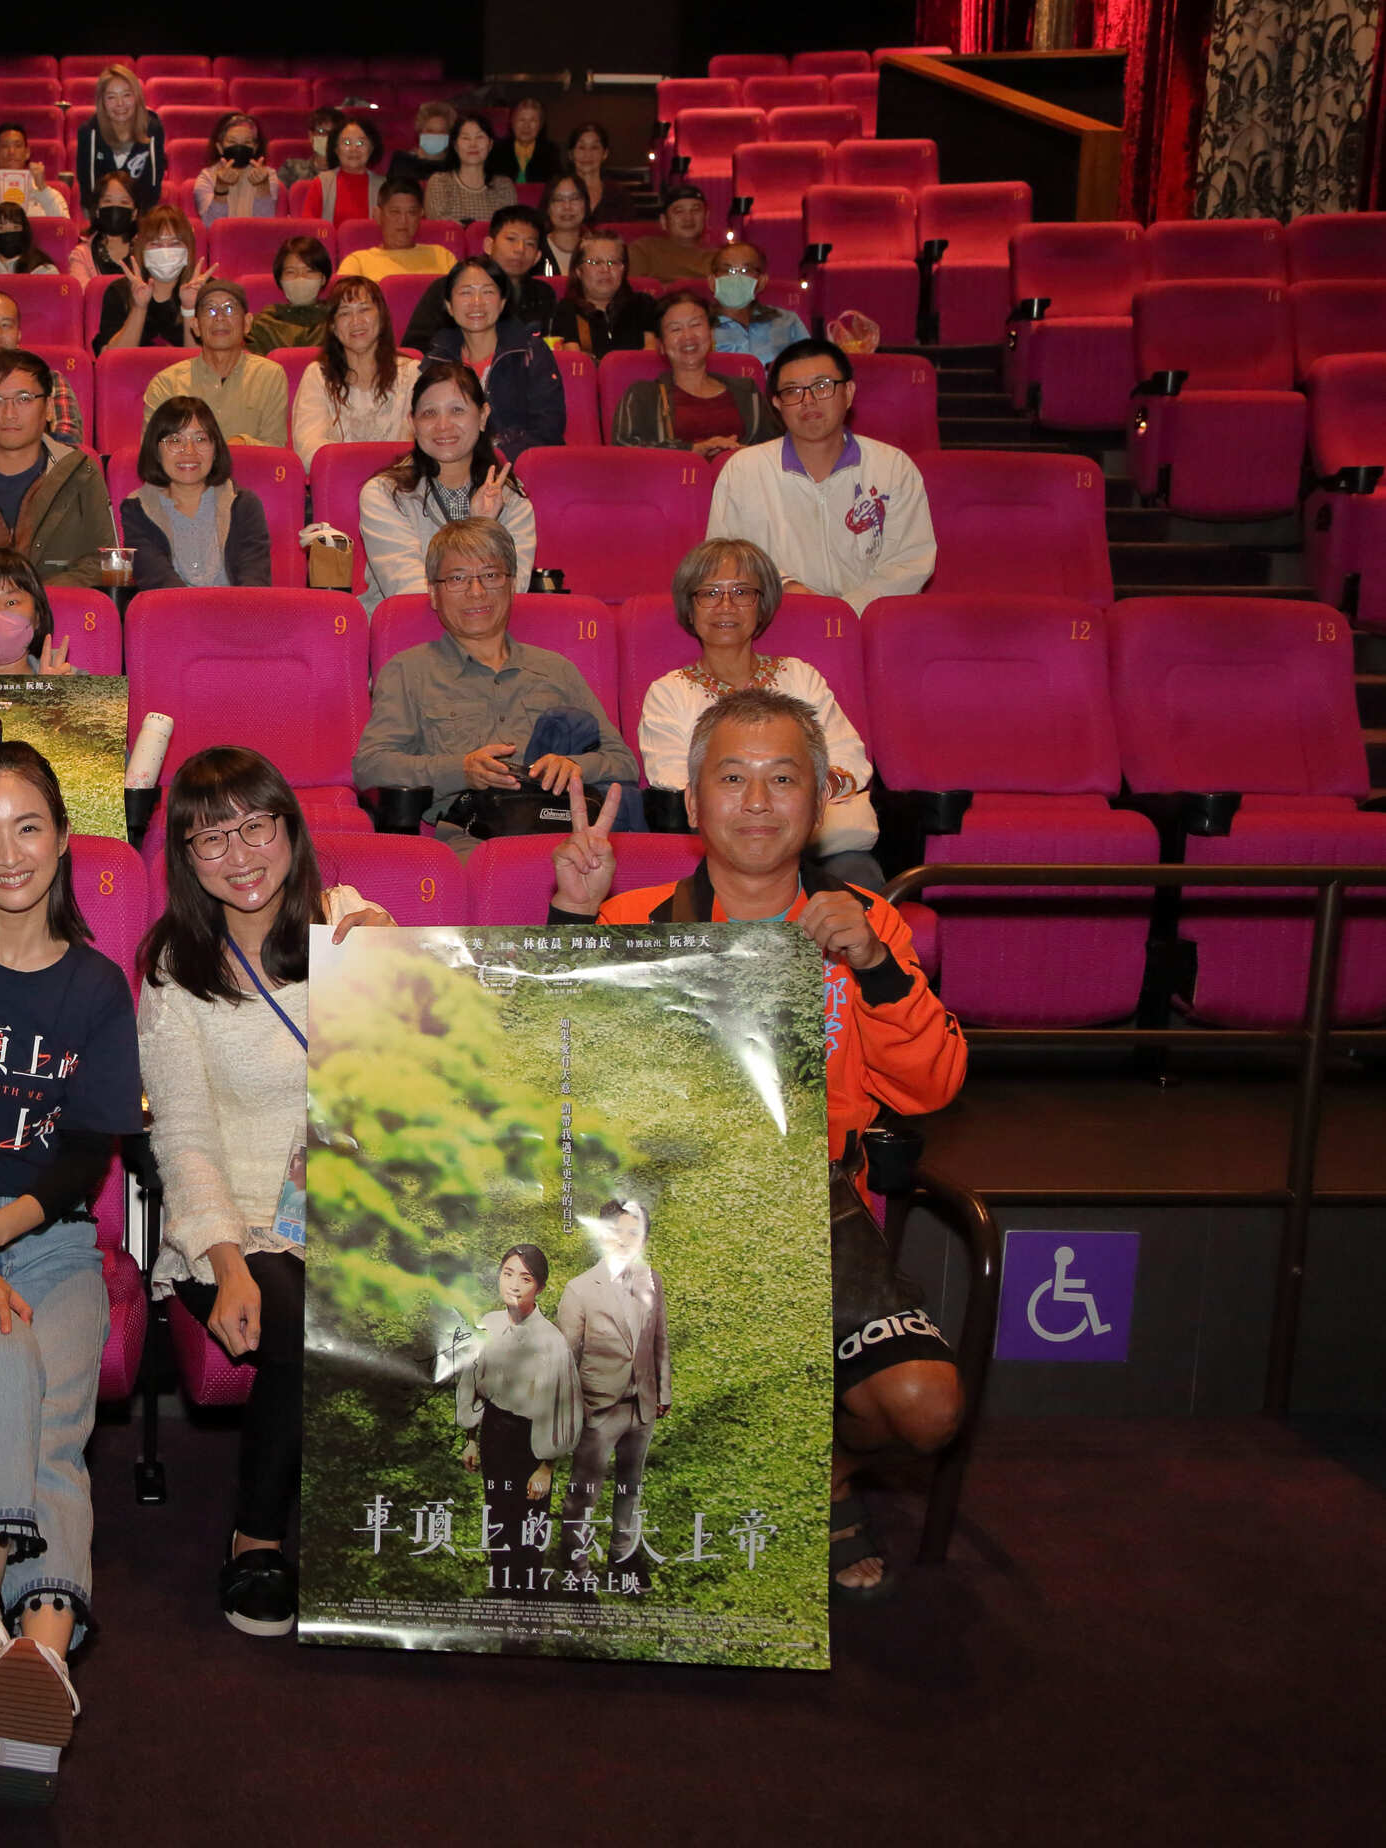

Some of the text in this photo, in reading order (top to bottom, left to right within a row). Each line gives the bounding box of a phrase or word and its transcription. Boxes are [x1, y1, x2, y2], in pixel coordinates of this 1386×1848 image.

[65, 358, 76, 372] 8
[570, 362, 585, 377] 11
[911, 368, 926, 384] 13
[274, 465, 286, 483] 9
[680, 468, 697, 486] 11
[1075, 471, 1093, 489] 13
[84, 612, 97, 632] 8
[334, 615, 347, 636] 9
[577, 619, 597, 640] 10
[823, 618, 843, 638] 11
[1069, 621, 1091, 641] 12
[1315, 622, 1337, 643] 13
[99, 870, 114, 896] 8
[420, 877, 435, 902] 9
[523, 937, 562, 950] 林依晨
[570, 937, 611, 950] 周渝民
[669, 935, 711, 948] 阮經天
[838, 1308, 951, 1360] adid
[486, 1479, 647, 1496] BE WITH ME
[353, 1494, 779, 1571] 車頂上的玄天上帝
[486, 1565, 641, 1597] 11.17 全台上映
